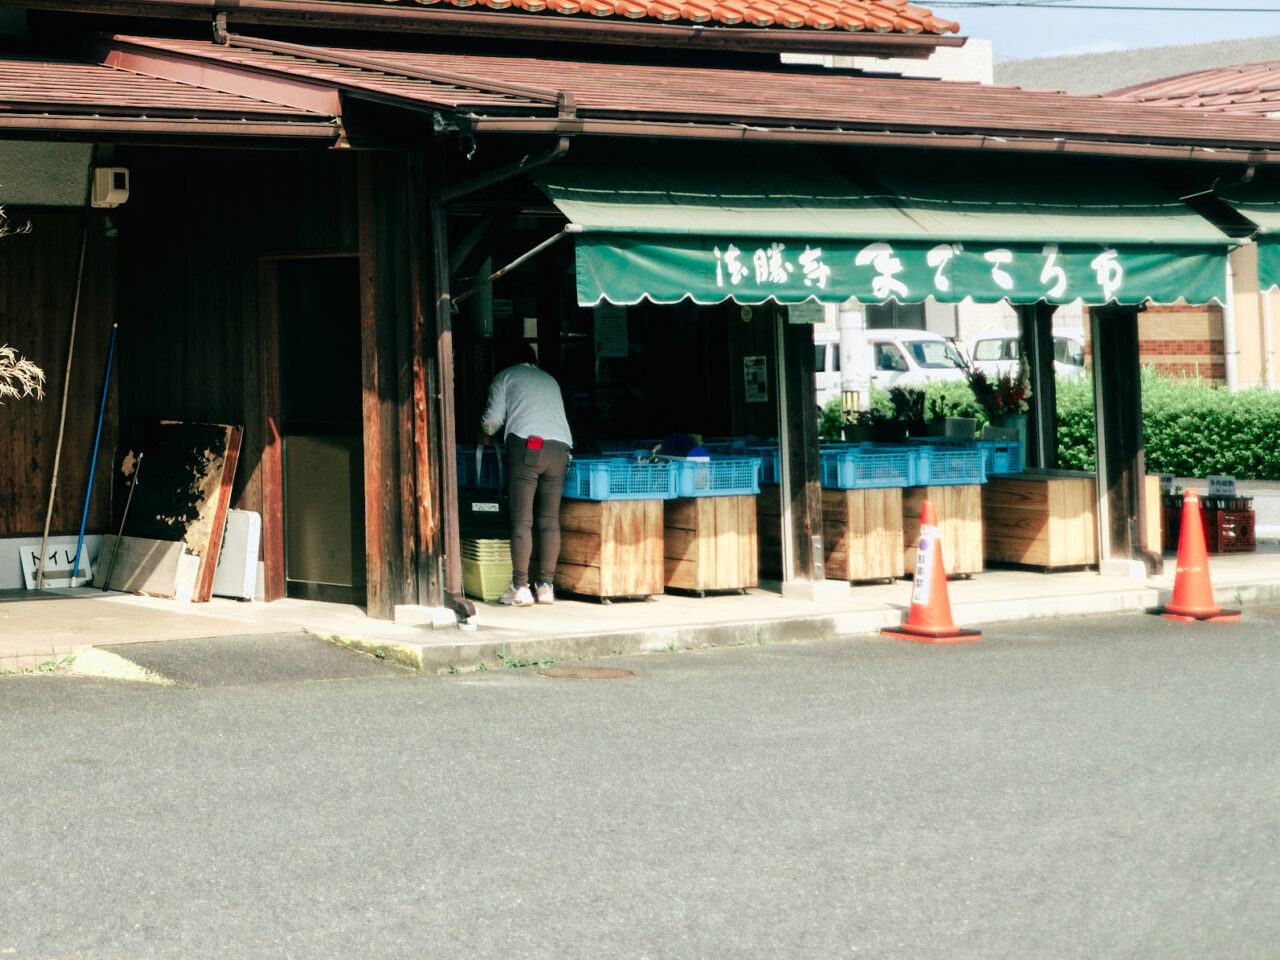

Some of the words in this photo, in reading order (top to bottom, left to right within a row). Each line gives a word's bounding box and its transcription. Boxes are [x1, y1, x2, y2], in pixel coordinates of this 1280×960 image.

[714, 242, 831, 289] 法勝寺
[31, 550, 78, 567] トイレ
